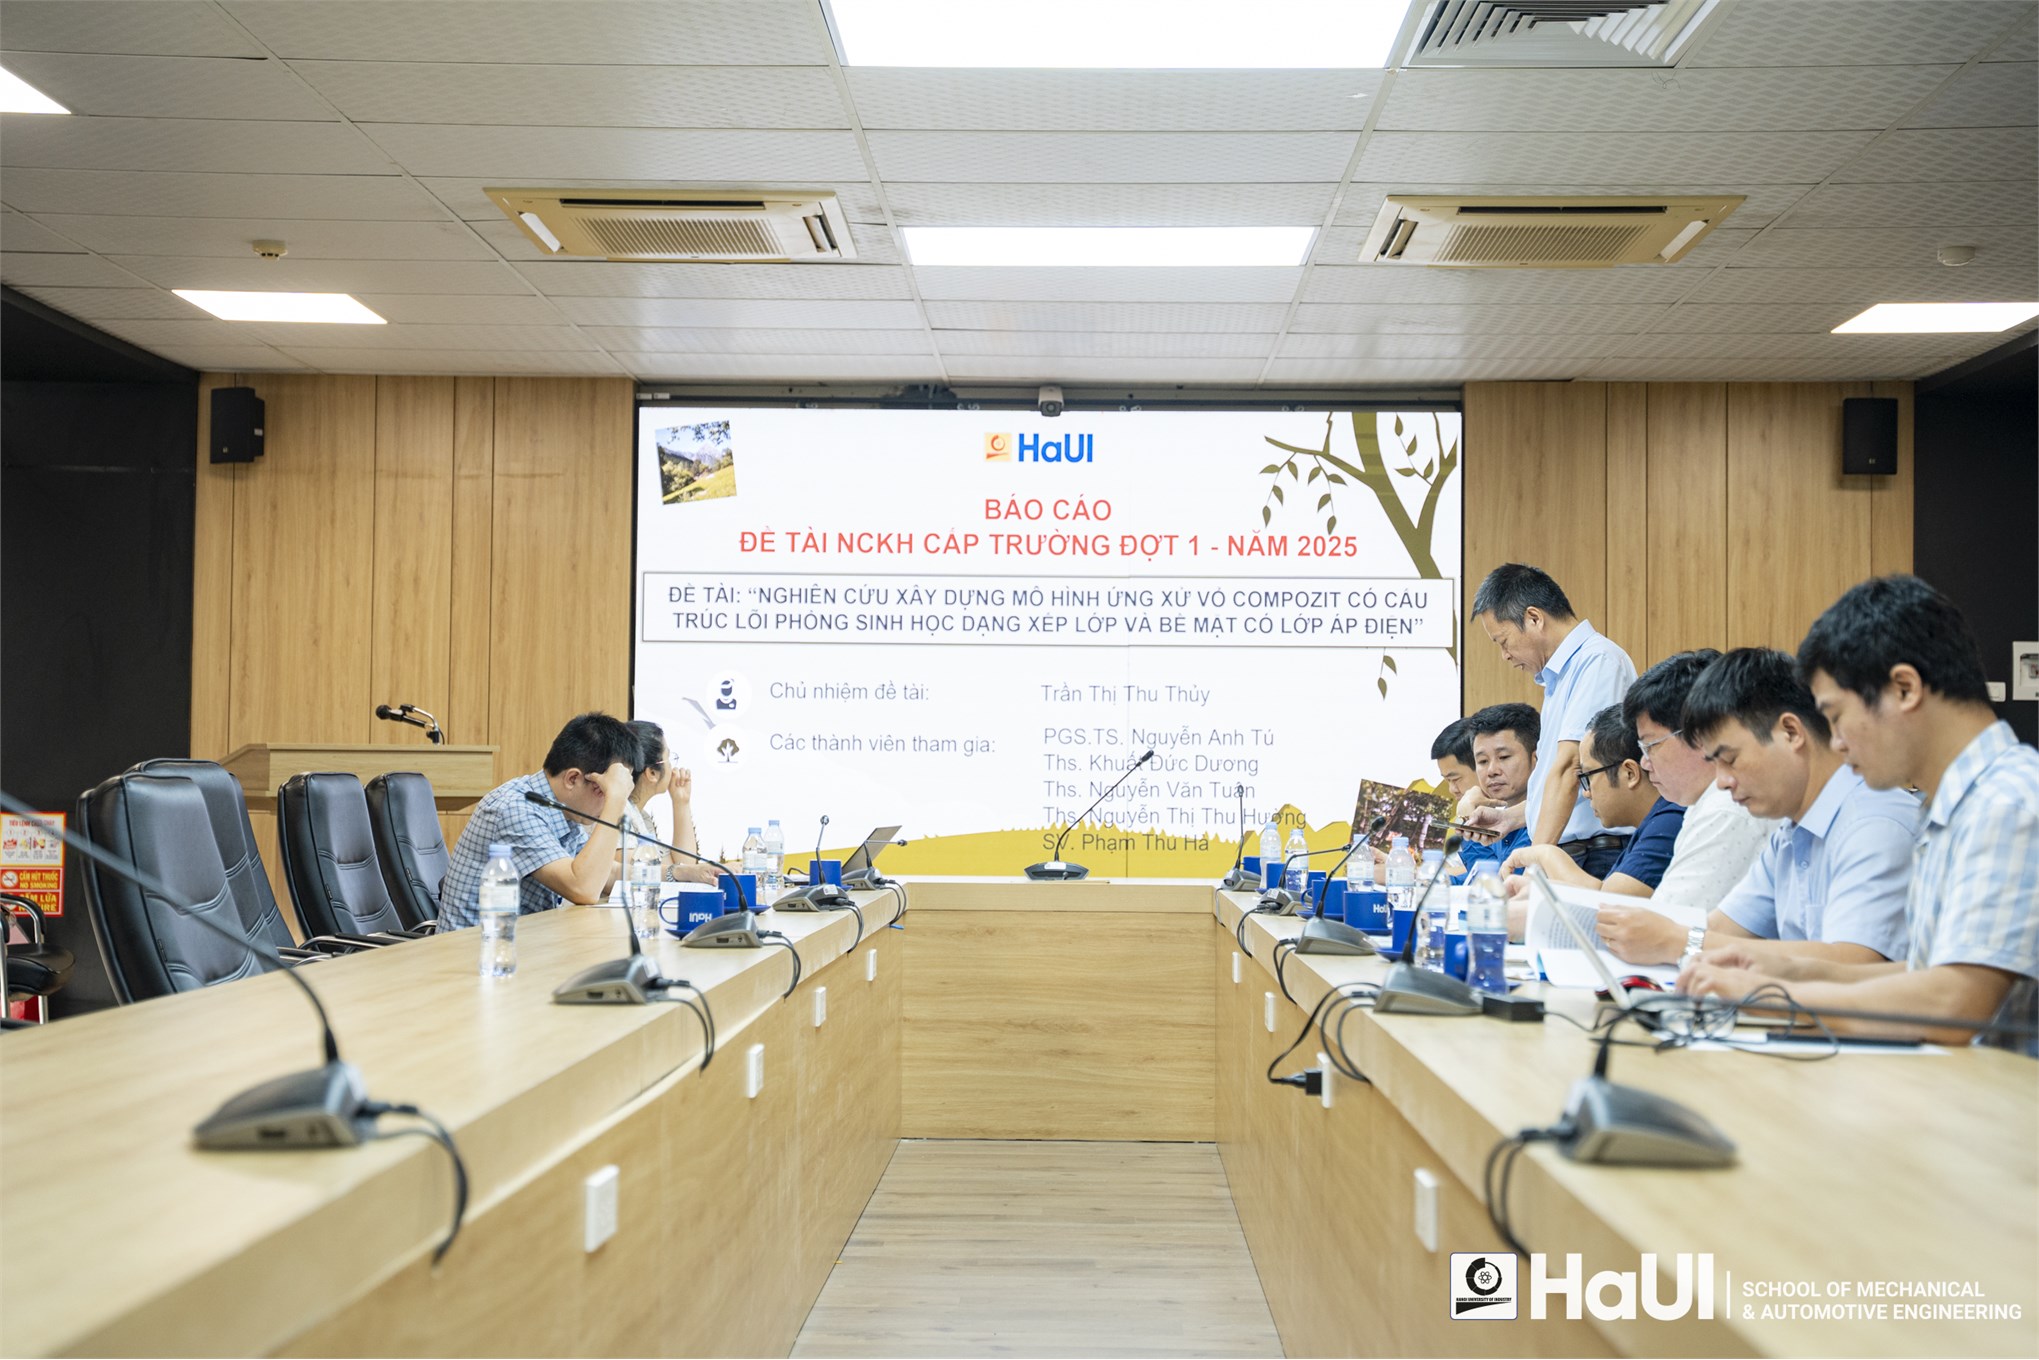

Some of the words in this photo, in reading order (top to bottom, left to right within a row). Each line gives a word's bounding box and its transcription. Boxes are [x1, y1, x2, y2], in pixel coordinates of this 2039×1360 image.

[1018, 433, 1093, 463] HaUI
[985, 493, 1043, 520] BÁO
[1053, 494, 1112, 521] CÁO
[739, 526, 775, 552] ĐỀ
[785, 526, 827, 553] TÀI
[837, 532, 913, 554] NCKH
[923, 527, 979, 554] CẤP
[989, 529, 1110, 556] TRƯỜNG
[1119, 534, 1179, 562] ĐỢT
[1188, 535, 1198, 556] 1
[1228, 529, 1288, 556] NĂM
[1298, 536, 1358, 557] 2025
[668, 582, 696, 603] ĐỀ
[703, 582, 741, 603] TÀI:
[844, 584, 889, 605] CỨU
[896, 584, 937, 605] XÂY
[944, 588, 1005, 611] DỰNG
[1012, 586, 1044, 606] MÔ
[1051, 586, 1100, 607] HÌNH
[1107, 586, 1153, 607] ỨNG
[1233, 591, 1341, 608] COMPOZIT
[1347, 587, 1378, 608] CÓ
[1384, 588, 1428, 609] CẤU
[673, 608, 728, 629] TRÚC
[736, 609, 768, 630] LÕI
[856, 614, 903, 631] SINH
[911, 615, 955, 637] HỌC
[962, 615, 1021, 637] DẠNG
[1075, 612, 1117, 633] LỚP
[1124, 612, 1152, 633] VÀ
[1244, 613, 1274, 634] CÓ
[1281, 613, 1323, 634] LỚP
[1330, 614, 1358, 634] ÁP
[770, 681, 807, 699] Chủ
[813, 682, 868, 703] nhiệm
[874, 680, 897, 700] đề
[903, 681, 929, 700] tài:
[1041, 682, 1082, 702] Trần
[1089, 685, 1117, 706] Thị
[1123, 685, 1158, 702] Thu
[1165, 684, 1211, 707] Thủy
[770, 733, 806, 751] Các
[812, 734, 862, 752] thành
[868, 734, 906, 752] viên
[912, 735, 957, 753] tham
[963, 736, 996, 757] gia:
[1044, 728, 1124, 745] PGS.TS.
[1132, 724, 1202, 750] Nguyễn
[1208, 728, 1244, 746] Anh
[1251, 729, 1274, 746] Tú
[1043, 754, 1082, 771] Ths.
[1150, 754, 1189, 772] Đức
[1195, 755, 1258, 776] Dương
[1043, 780, 1082, 798] Ths.
[1090, 778, 1160, 802] Nguyễn
[1167, 781, 1202, 798] Văn
[1089, 804, 1160, 829] Nguyễn
[1167, 808, 1195, 827] Thị
[1201, 808, 1236, 825] Thu
[1043, 833, 1074, 851] SV.
[1082, 834, 1136, 854] Phạm
[1142, 834, 1177, 851] Thu
[1184, 834, 1209, 851] Hà
